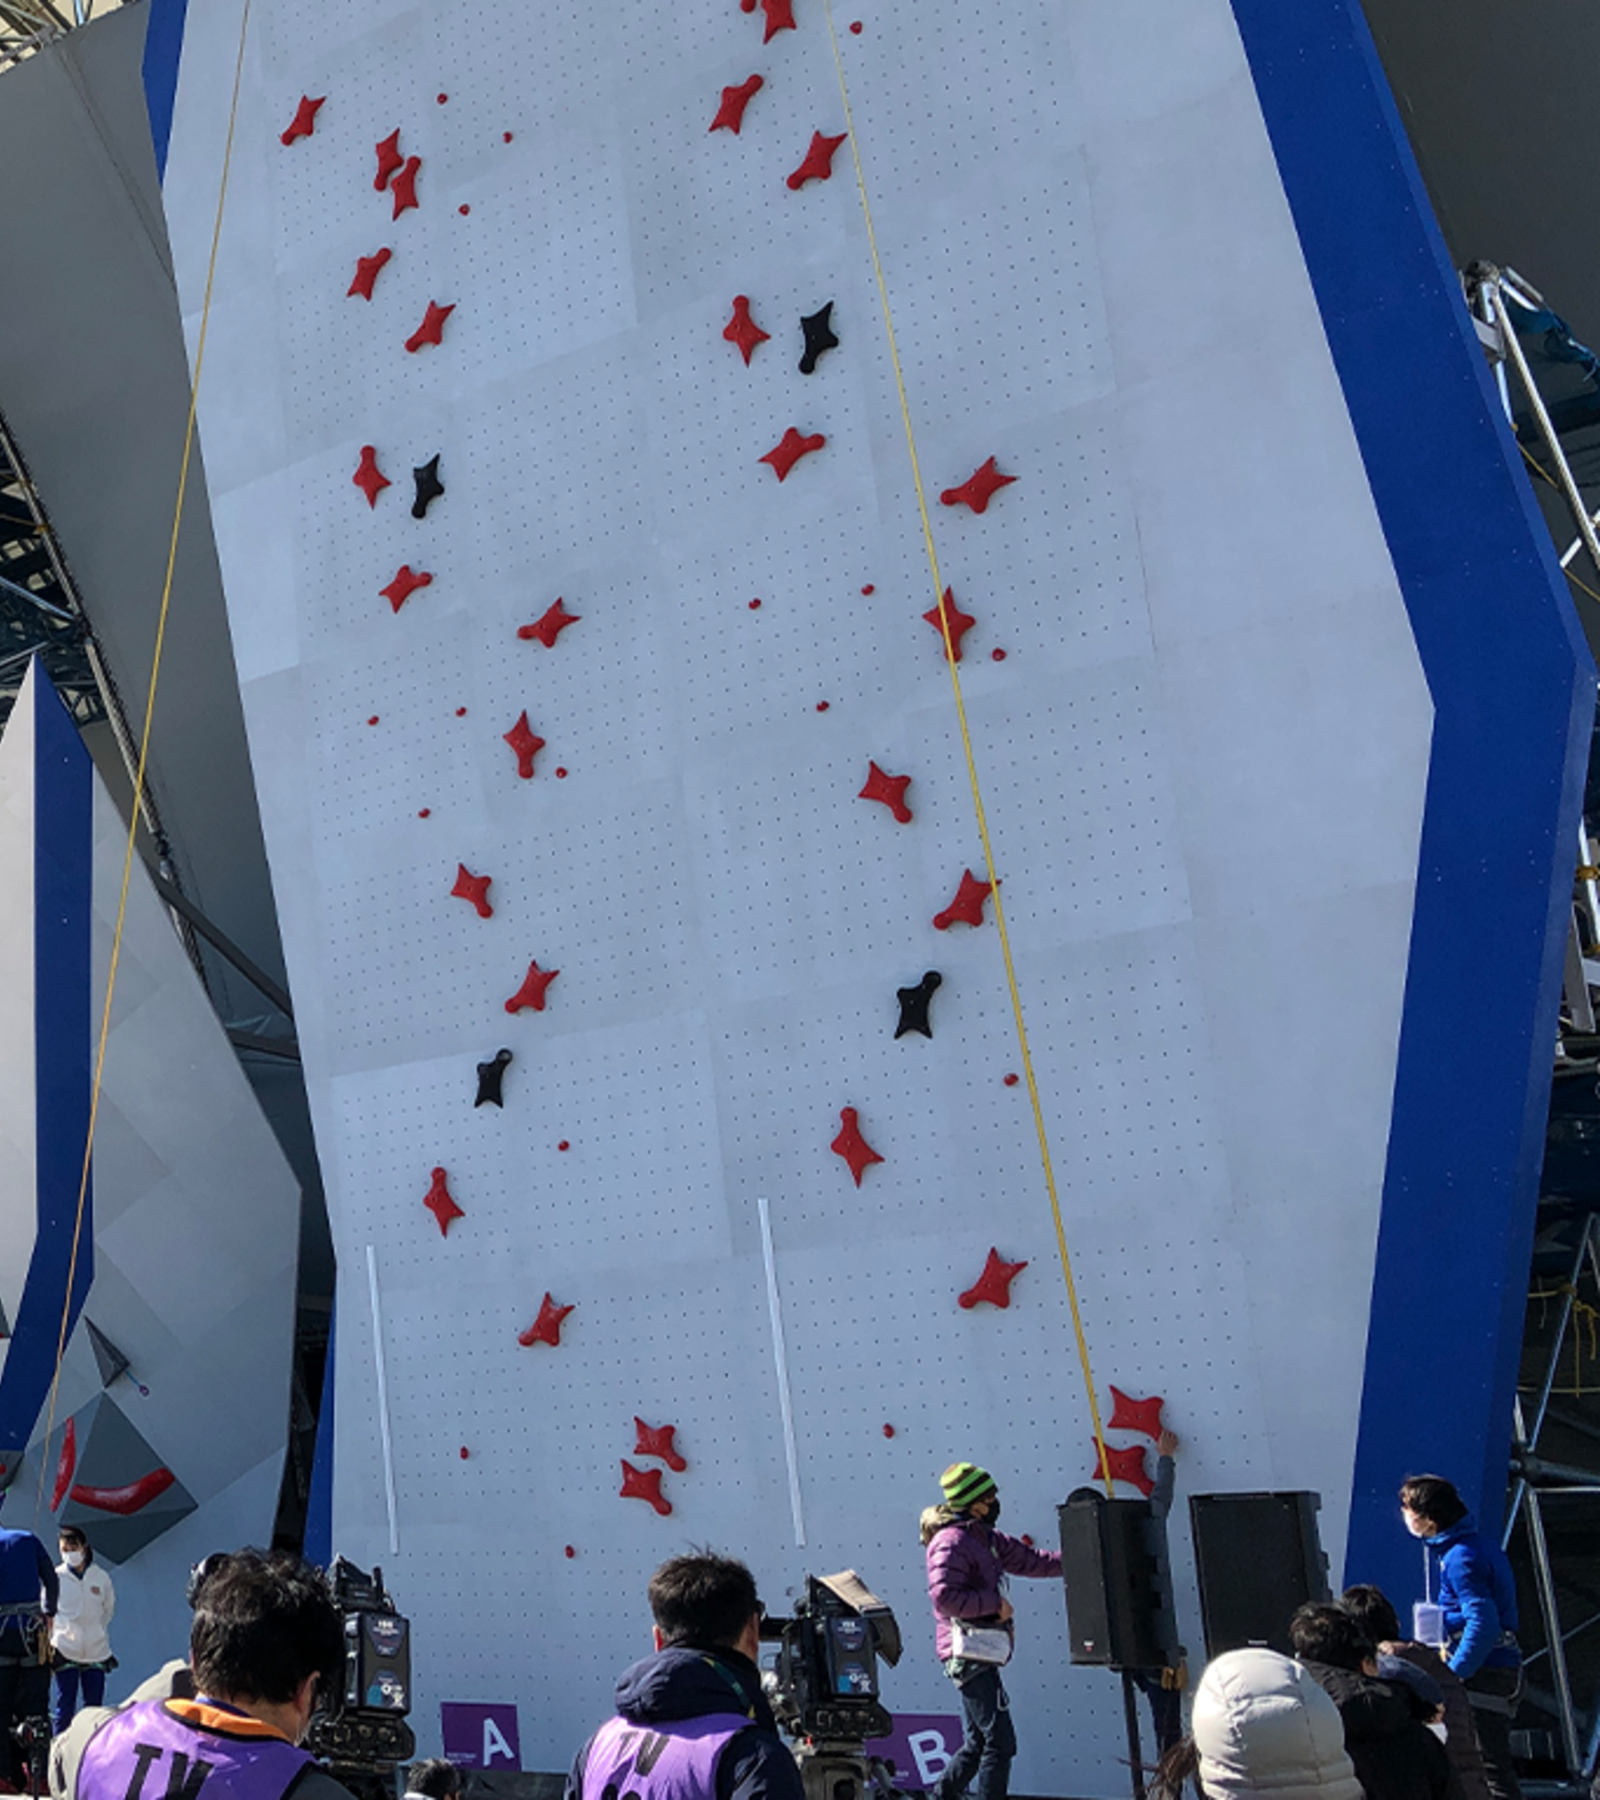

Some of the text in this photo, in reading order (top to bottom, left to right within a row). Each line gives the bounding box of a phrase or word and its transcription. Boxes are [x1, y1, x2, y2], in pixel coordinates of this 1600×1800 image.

[483, 1717, 515, 1767] A
[612, 1731, 670, 1777] TV
[908, 1729, 952, 1785] B
[124, 1743, 214, 1800] TV
